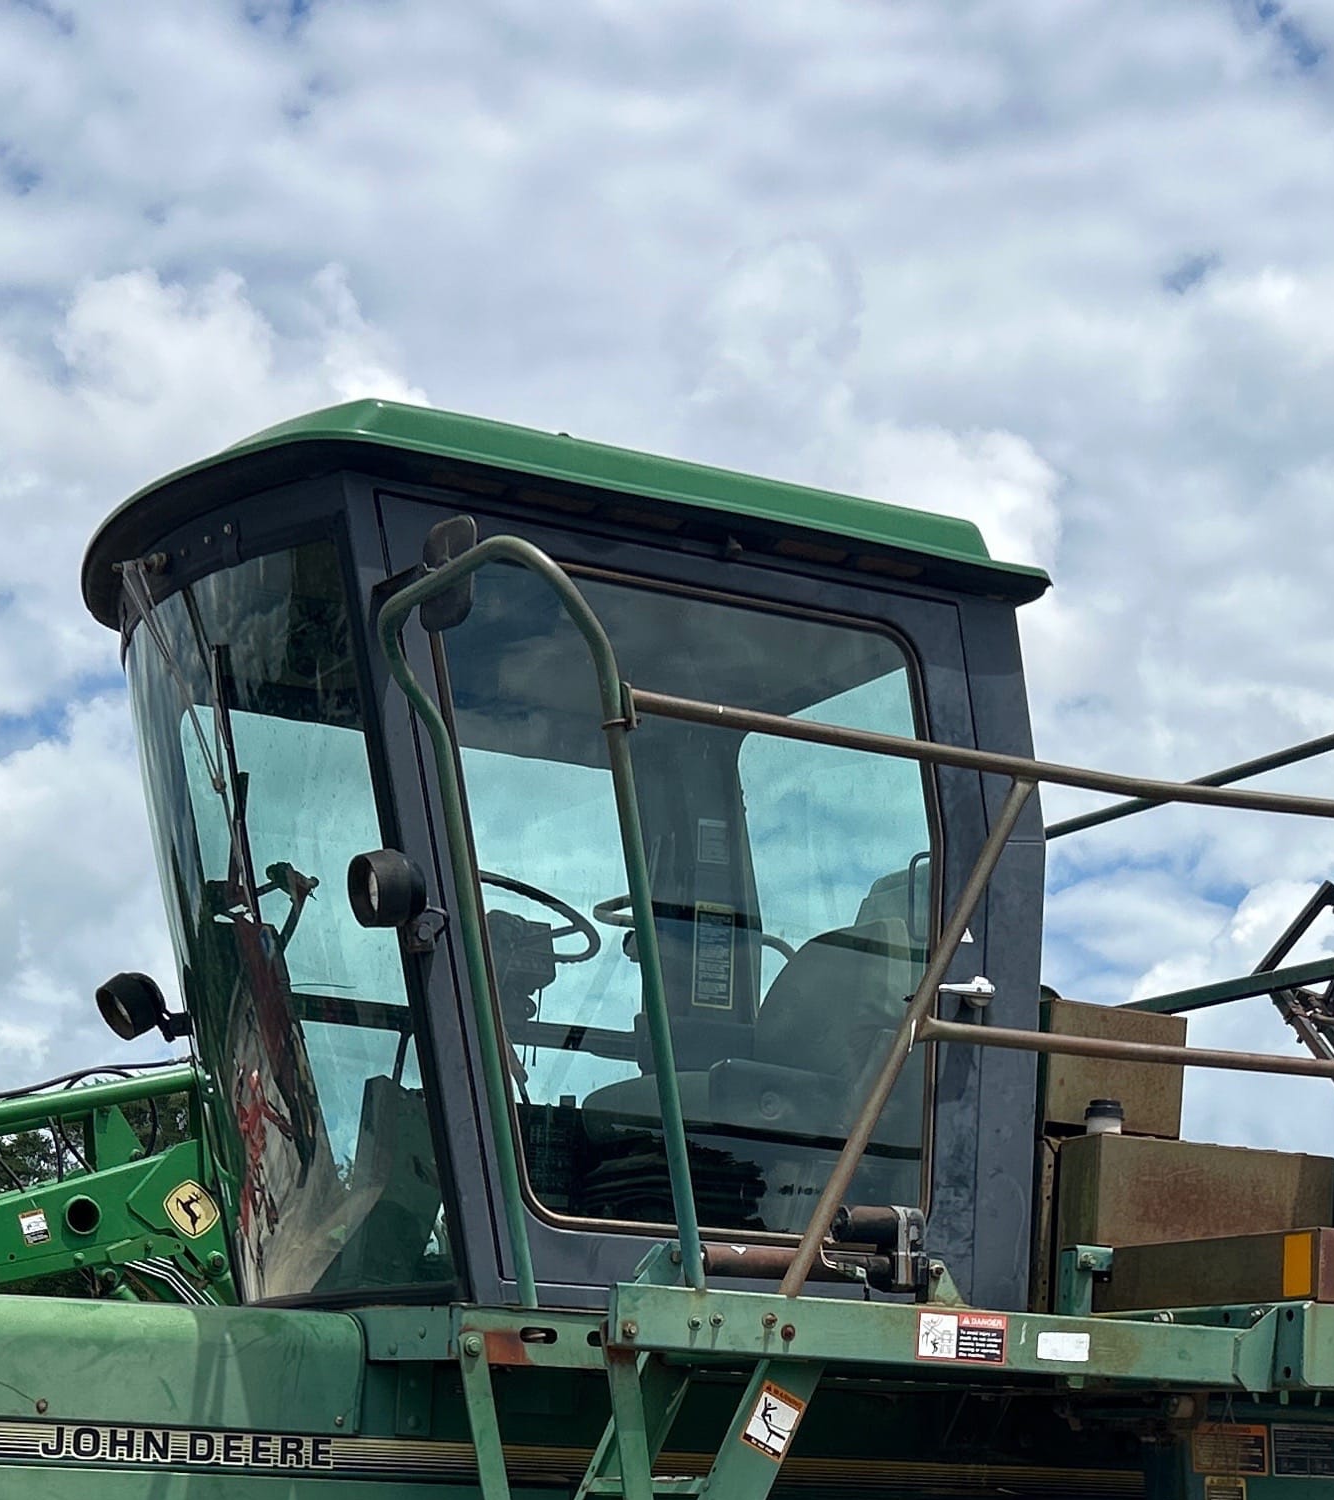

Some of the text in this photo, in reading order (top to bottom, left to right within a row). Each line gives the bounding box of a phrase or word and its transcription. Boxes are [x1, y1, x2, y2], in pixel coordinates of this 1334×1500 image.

[971, 1316, 1003, 1328] DANGER
[39, 1424, 334, 1469] JOHN DEERE
